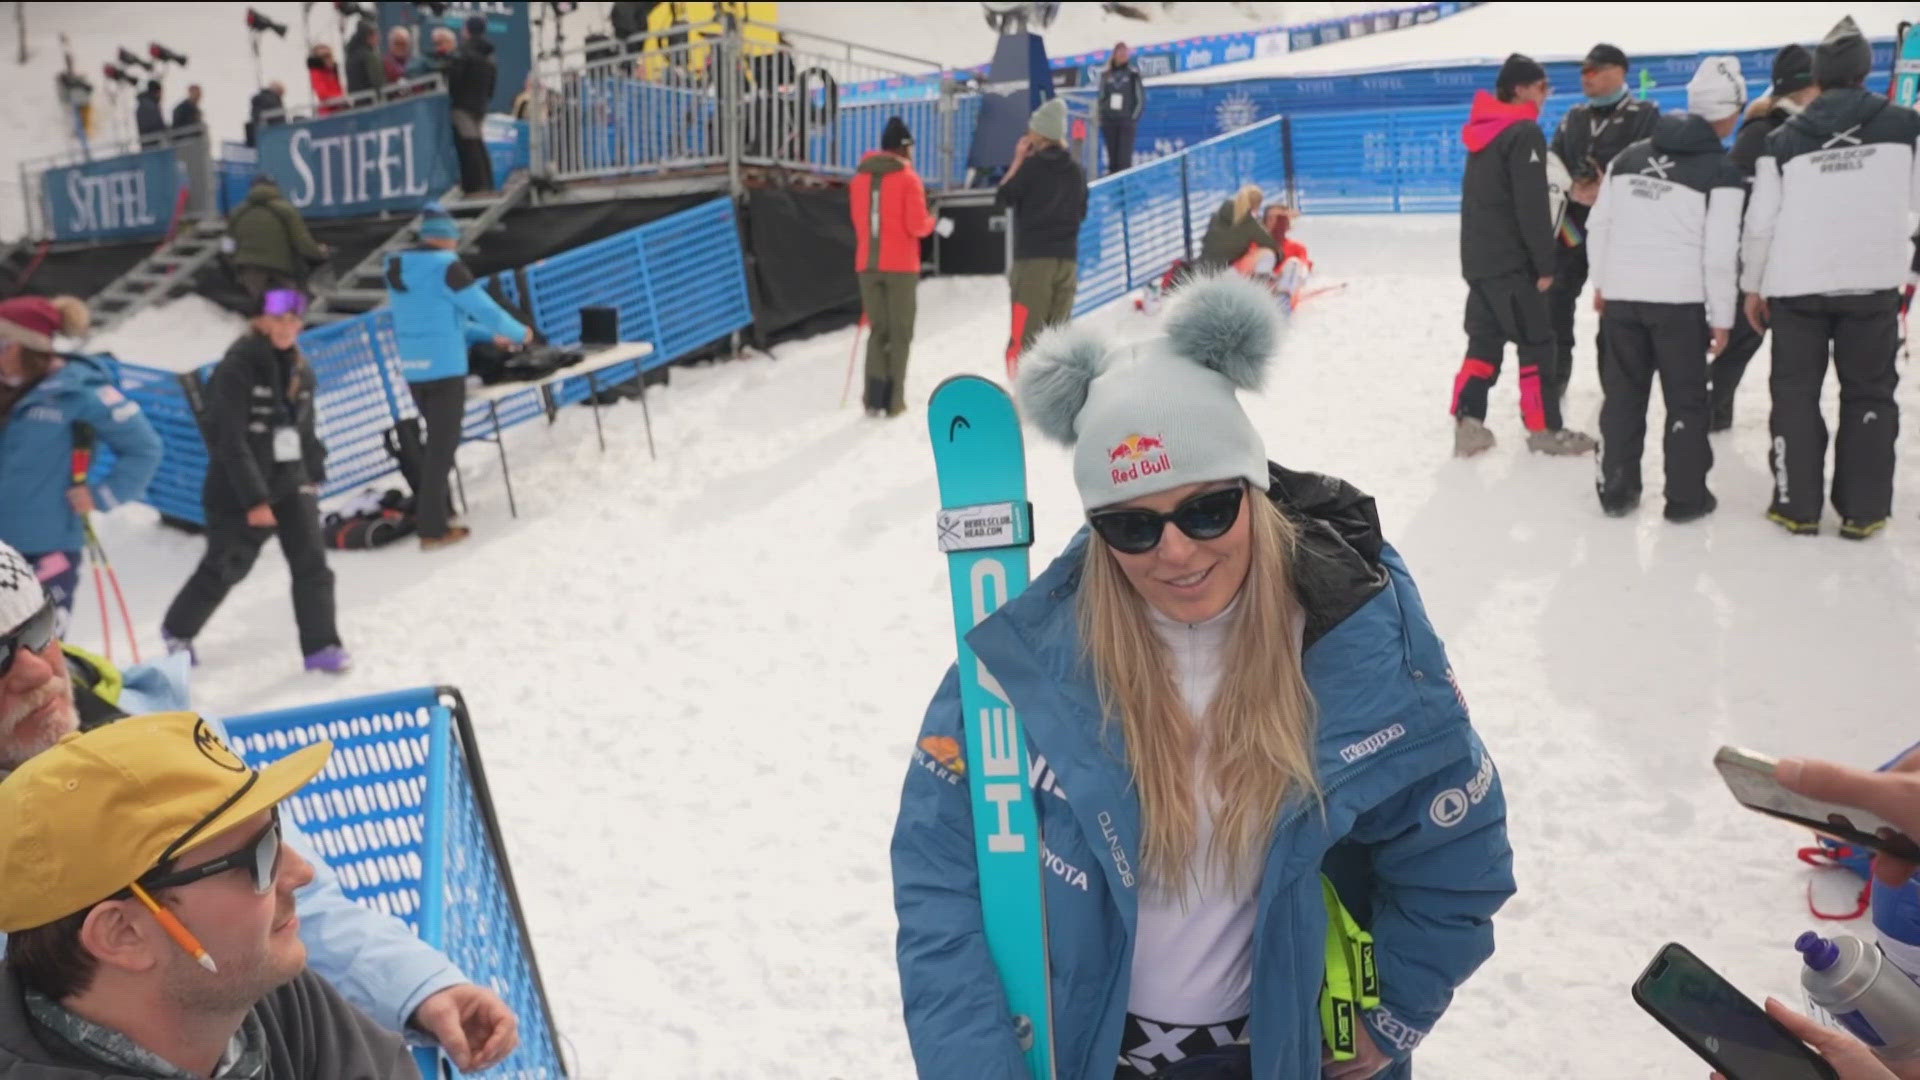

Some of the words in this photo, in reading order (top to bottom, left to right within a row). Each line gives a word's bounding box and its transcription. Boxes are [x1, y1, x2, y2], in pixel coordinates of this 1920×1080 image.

[289, 124, 429, 208] STIFEL
[66, 169, 156, 232] STIFEL
[1111, 462, 1138, 484] Red
[1140, 453, 1171, 475] Bull
[1340, 723, 1406, 763] Kappa
[1042, 846, 1088, 892] YOTA
[1362, 945, 1376, 992] LEKI
[1337, 1002, 1351, 1047] LEKI
